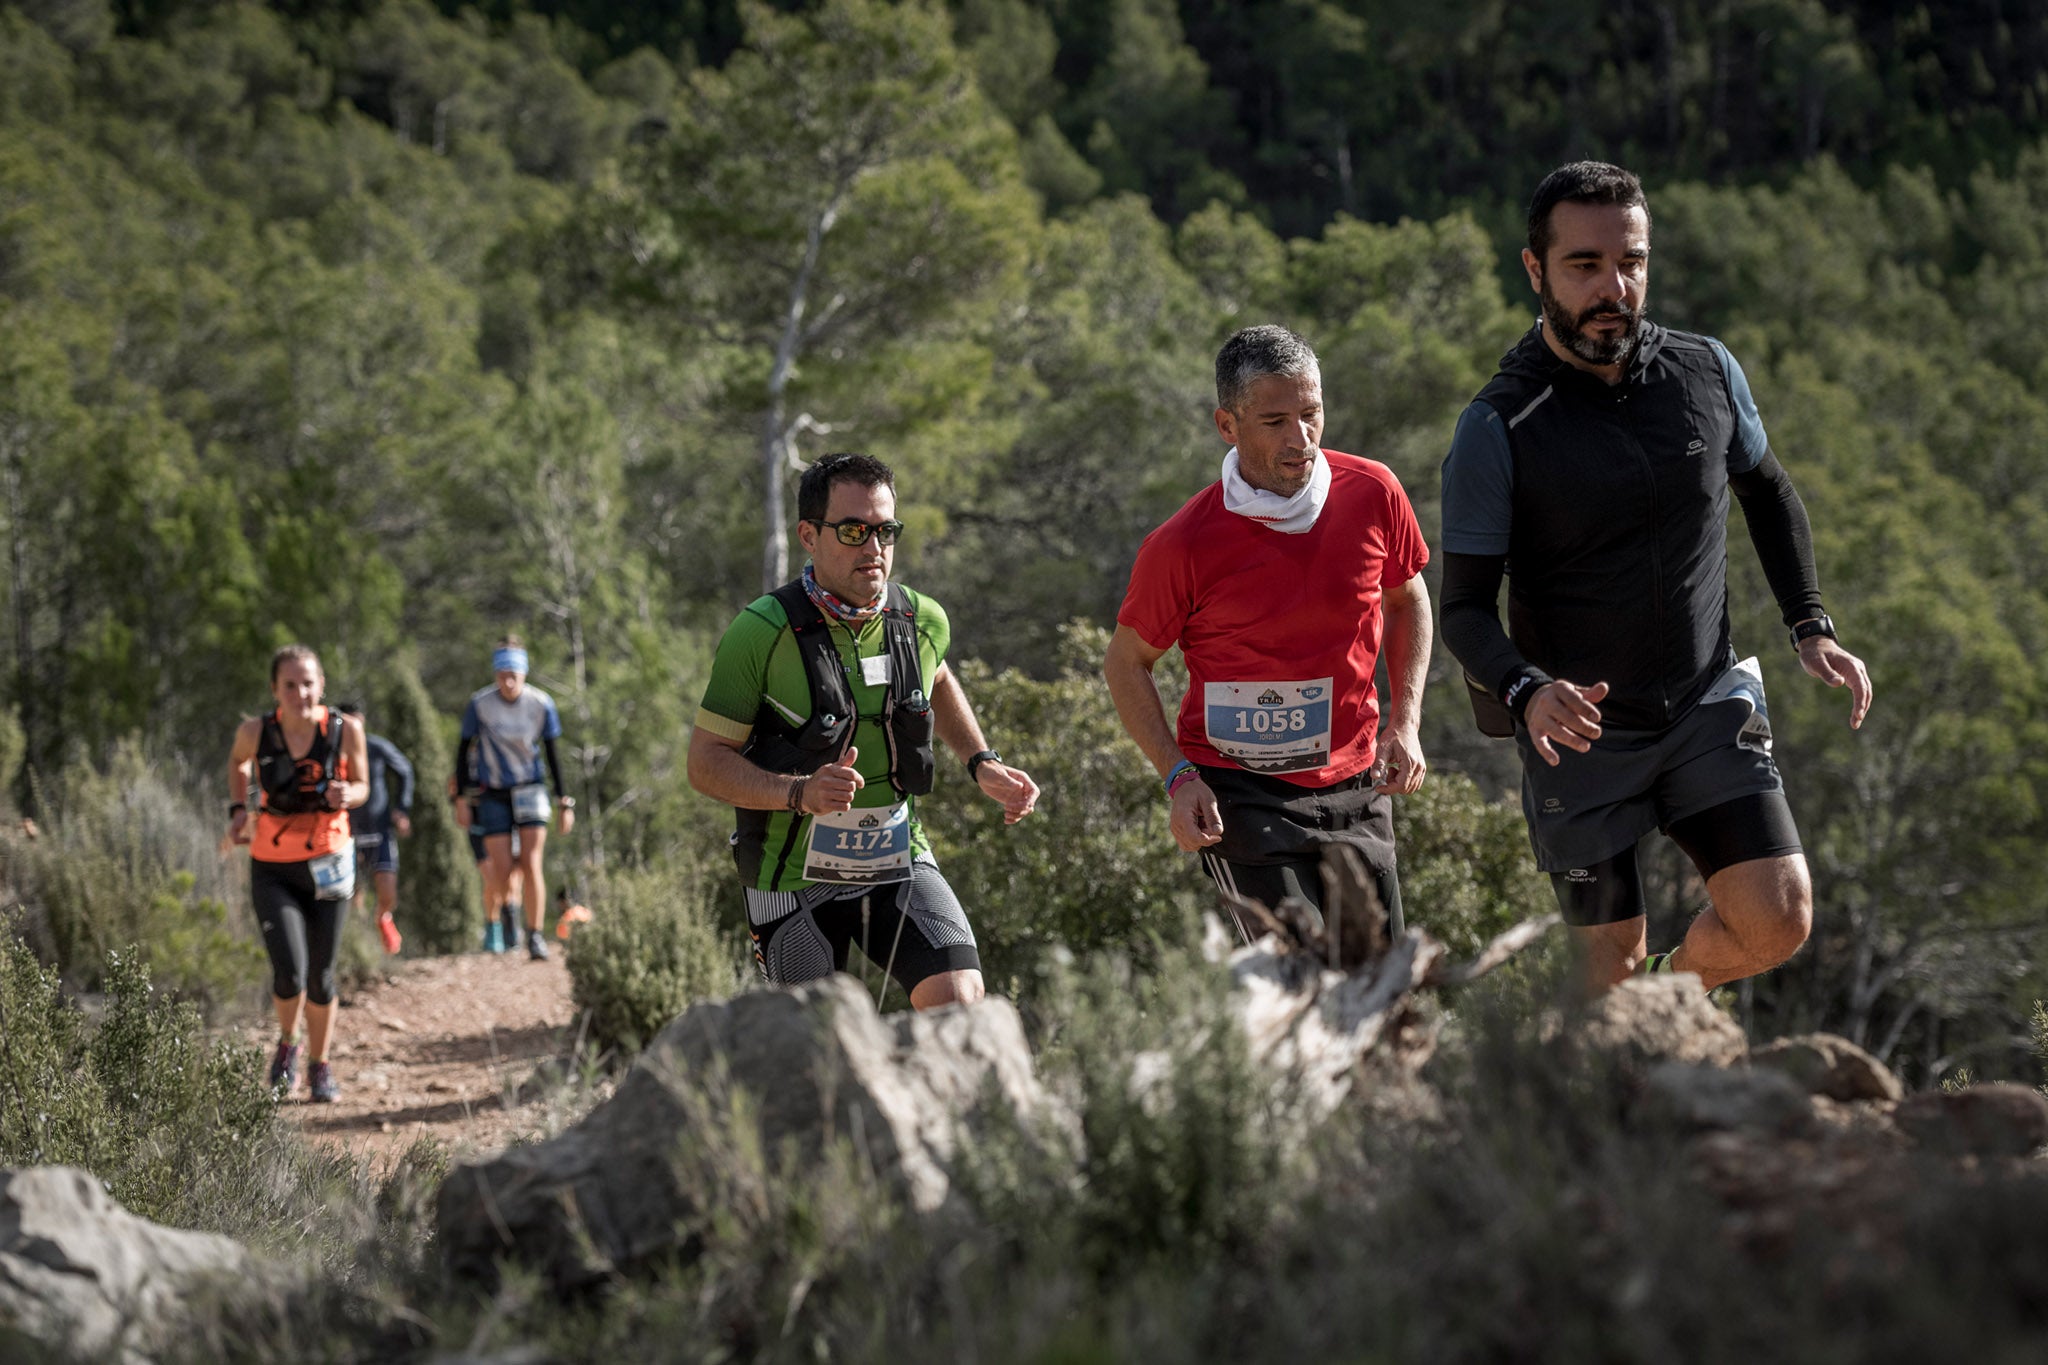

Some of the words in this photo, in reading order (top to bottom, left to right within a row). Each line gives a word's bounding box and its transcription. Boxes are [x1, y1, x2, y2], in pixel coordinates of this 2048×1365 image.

[1305, 688, 1319, 696] 15K
[1504, 676, 1532, 708] FILA
[1235, 709, 1306, 733] 1058
[835, 829, 893, 850] 1172
